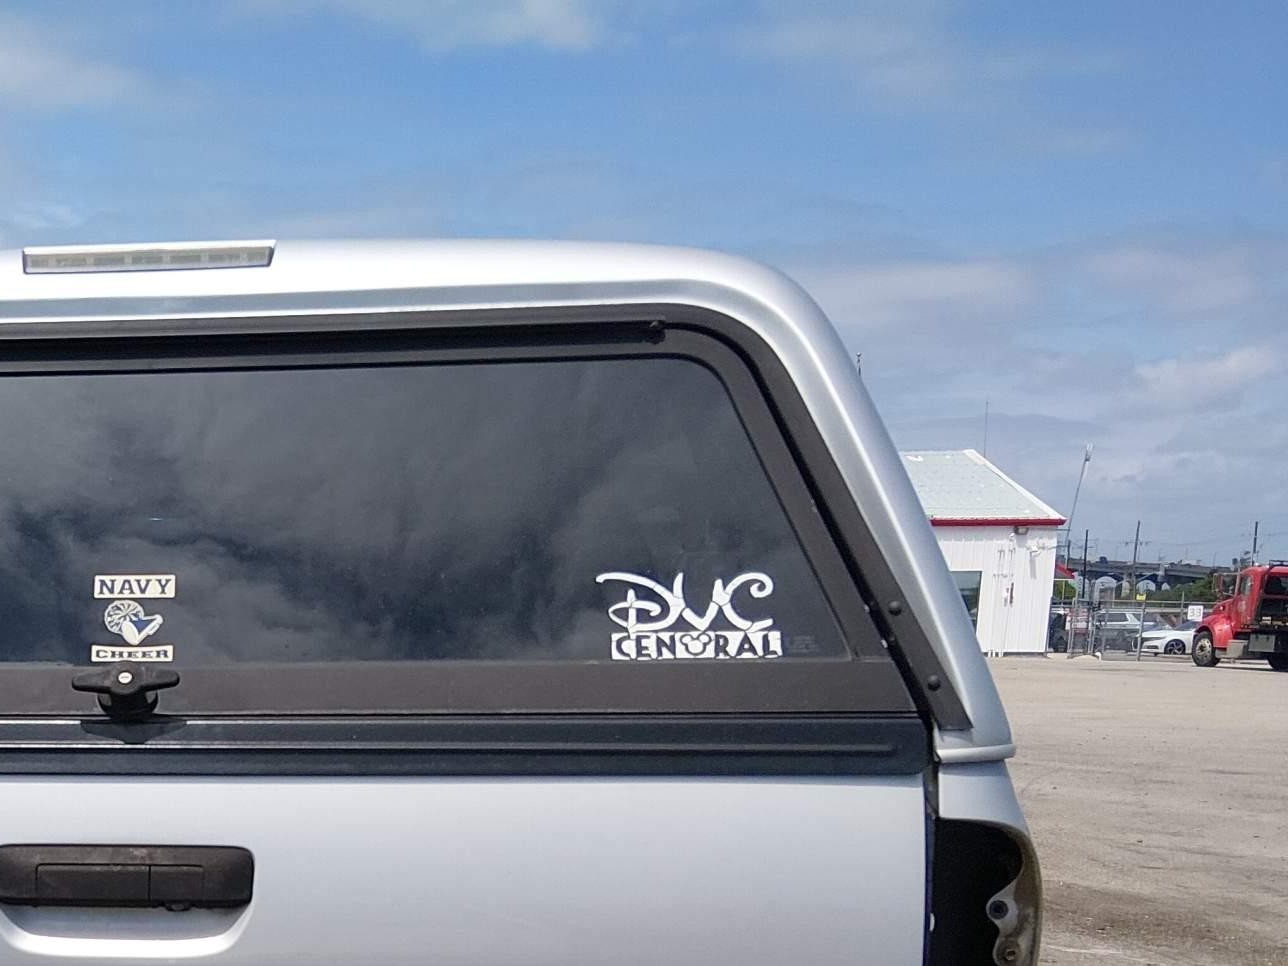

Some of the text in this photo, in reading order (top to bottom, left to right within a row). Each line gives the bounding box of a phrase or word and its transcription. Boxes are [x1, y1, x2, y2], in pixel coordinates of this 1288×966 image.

[98, 579, 171, 595] NAVY
[596, 572, 774, 632] DVC
[95, 649, 169, 660] CHEER
